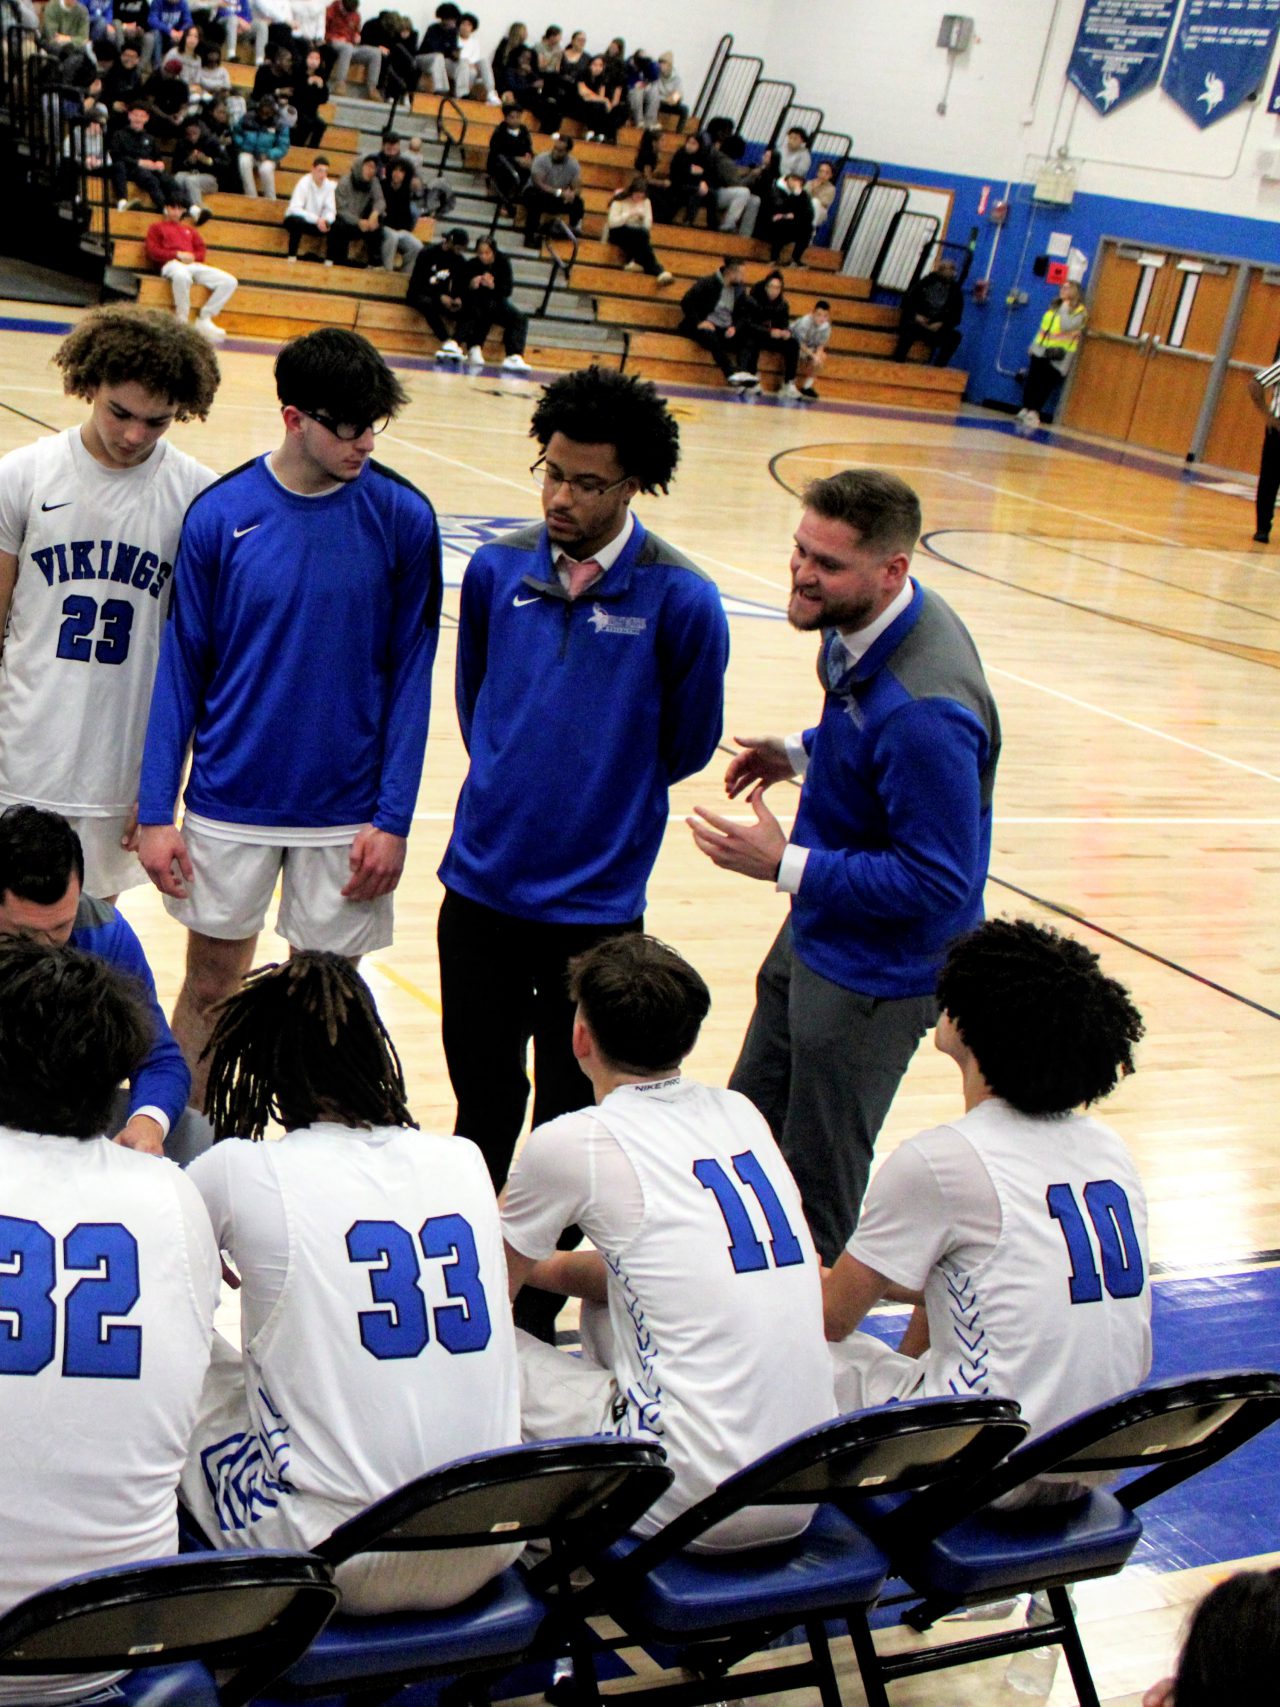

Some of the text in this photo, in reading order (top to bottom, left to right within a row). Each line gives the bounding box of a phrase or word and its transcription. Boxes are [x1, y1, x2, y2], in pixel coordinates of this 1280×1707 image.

[31, 540, 173, 599] VIKINGS
[56, 594, 134, 665] 23
[635, 1082, 661, 1092] NIKE
[692, 1149, 804, 1274] 11
[1046, 1179, 1144, 1304] 10
[345, 1213, 492, 1360] 33
